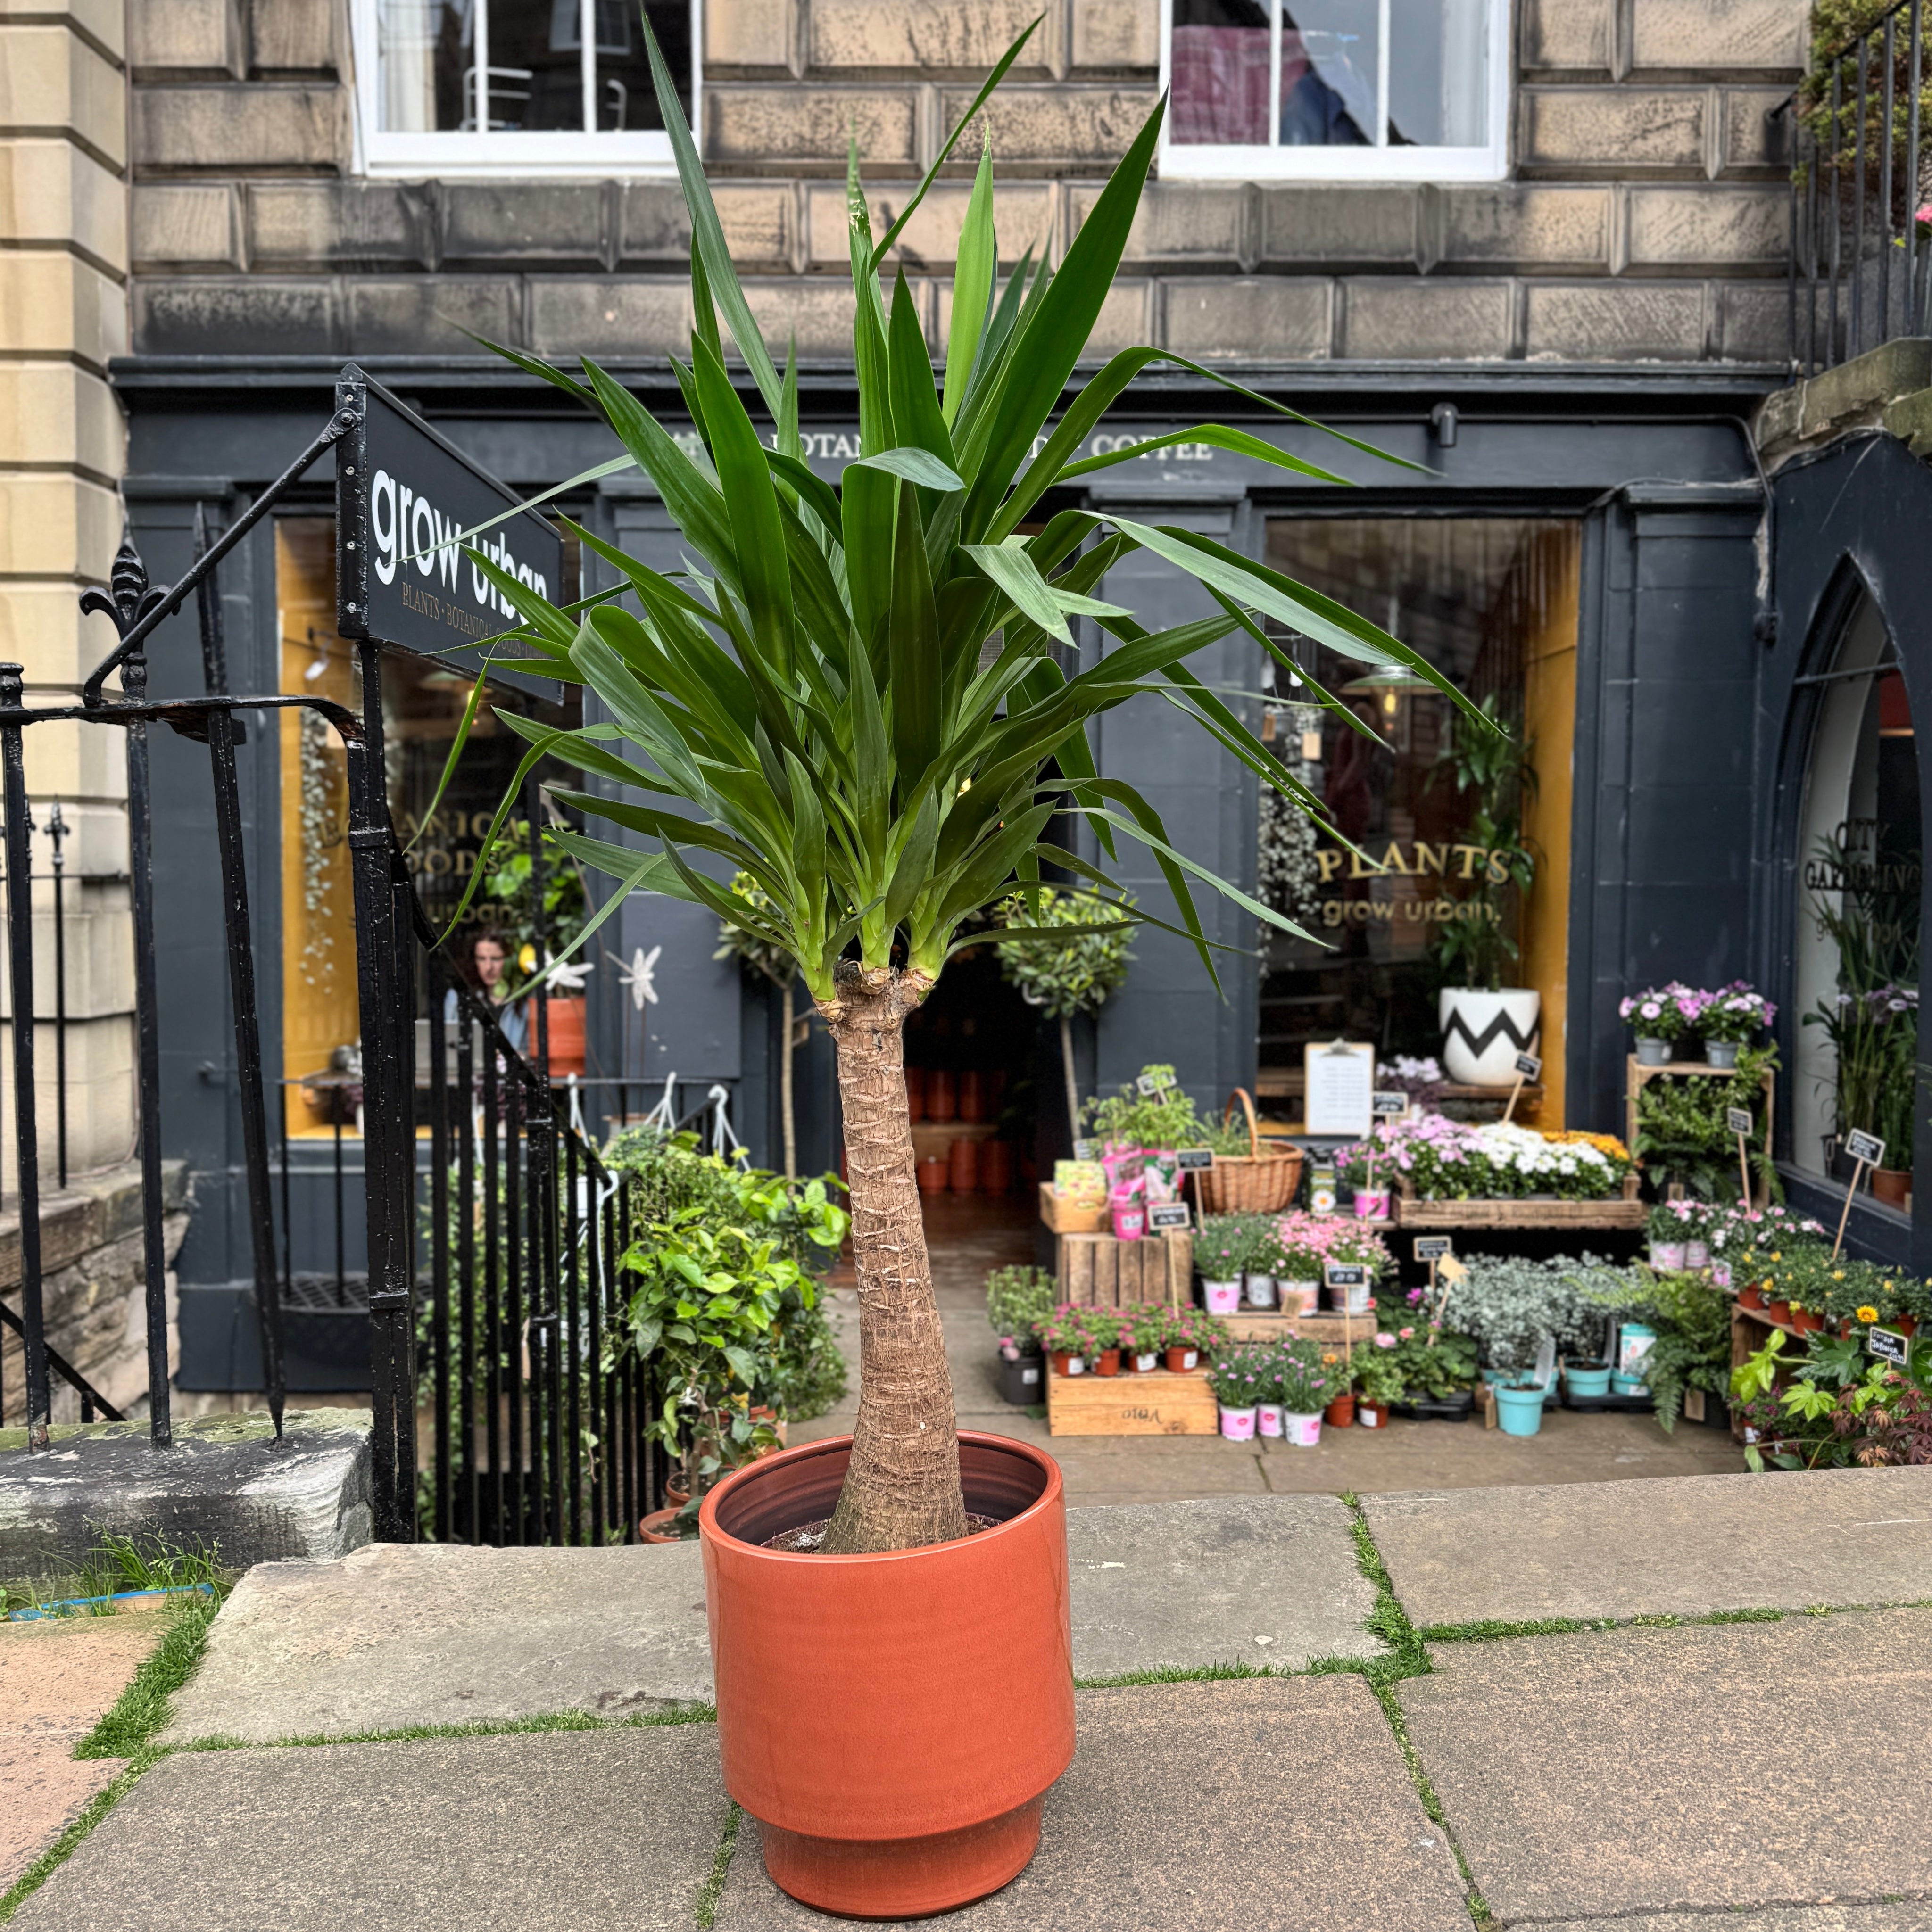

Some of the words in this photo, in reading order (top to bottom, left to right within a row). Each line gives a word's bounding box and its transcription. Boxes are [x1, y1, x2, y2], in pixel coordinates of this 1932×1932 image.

[372, 470, 462, 594] grow
[472, 531, 547, 631] urban
[402, 582, 439, 620] PLANTS
[1314, 841, 1511, 884] PLANTS
[1323, 899, 1394, 927] grow
